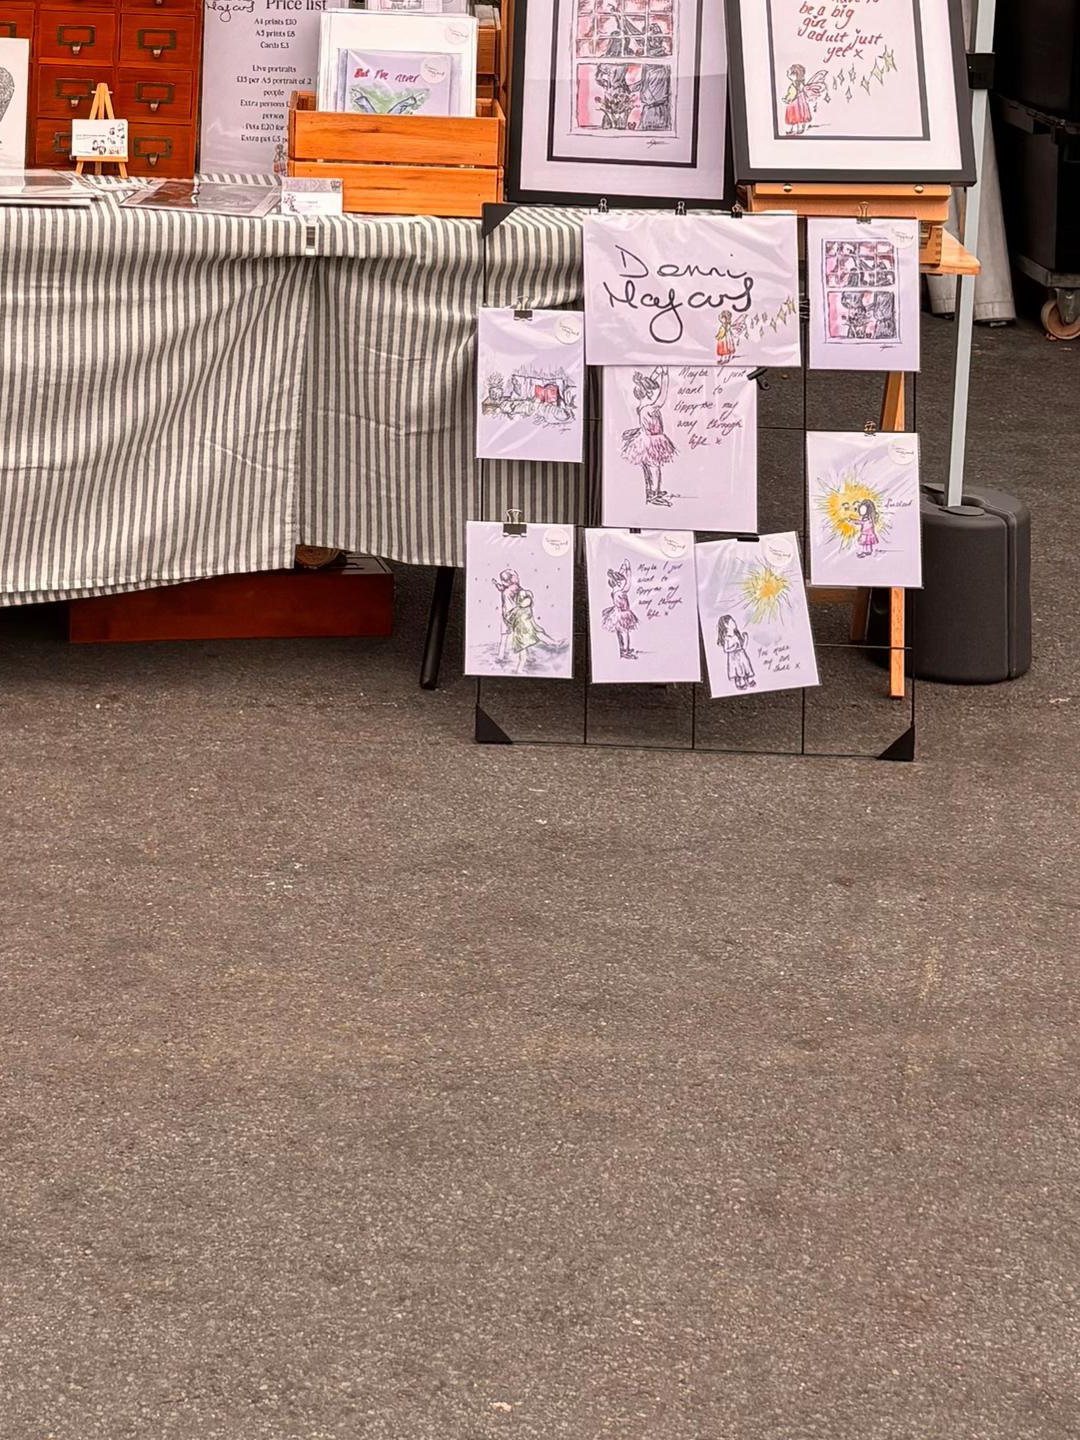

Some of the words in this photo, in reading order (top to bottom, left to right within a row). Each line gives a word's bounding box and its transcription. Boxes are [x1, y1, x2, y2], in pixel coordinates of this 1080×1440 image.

[799, 1, 815, 15] be
[817, 6, 826, 16] a
[831, 4, 855, 29] big
[266, 30, 285, 38] prints
[807, 29, 848, 43] adult
[850, 28, 883, 49] just
[823, 43, 853, 63] yet
[354, 68, 369, 78] But
[375, 69, 388, 80] I've
[395, 74, 420, 83] never
[240, 99, 258, 107] Extra
[677, 385, 703, 394] want
[713, 385, 723, 395] to
[720, 401, 739, 421] my
[677, 420, 697, 434] way
[706, 419, 742, 436] through
[689, 434, 708, 450] life
